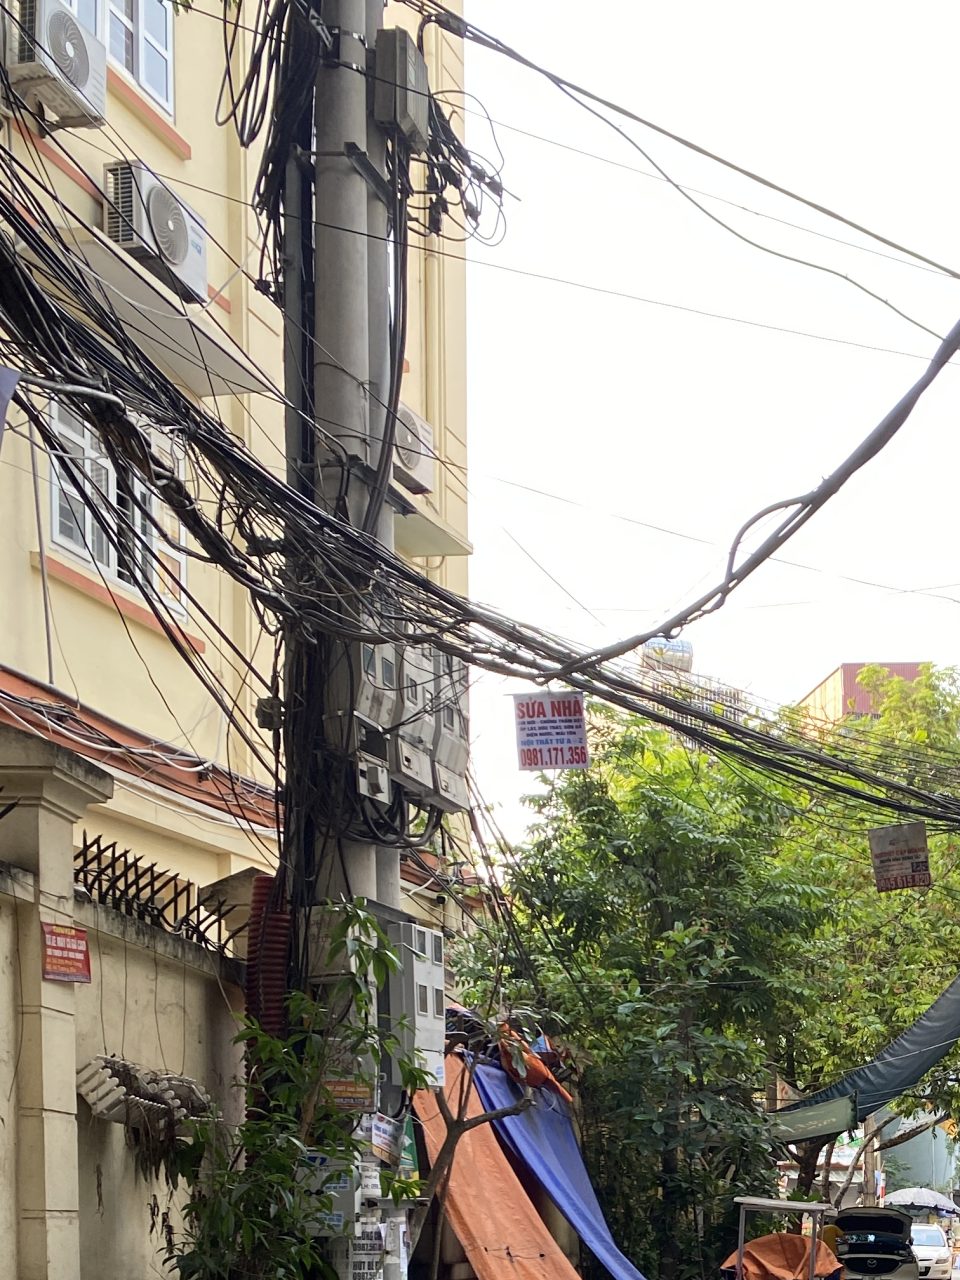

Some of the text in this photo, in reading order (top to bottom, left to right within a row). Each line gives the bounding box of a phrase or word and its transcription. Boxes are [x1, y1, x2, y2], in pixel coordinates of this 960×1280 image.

[517, 696, 583, 719] SỬA NHÀ
[520, 746, 587, 767] 0981.171.356
